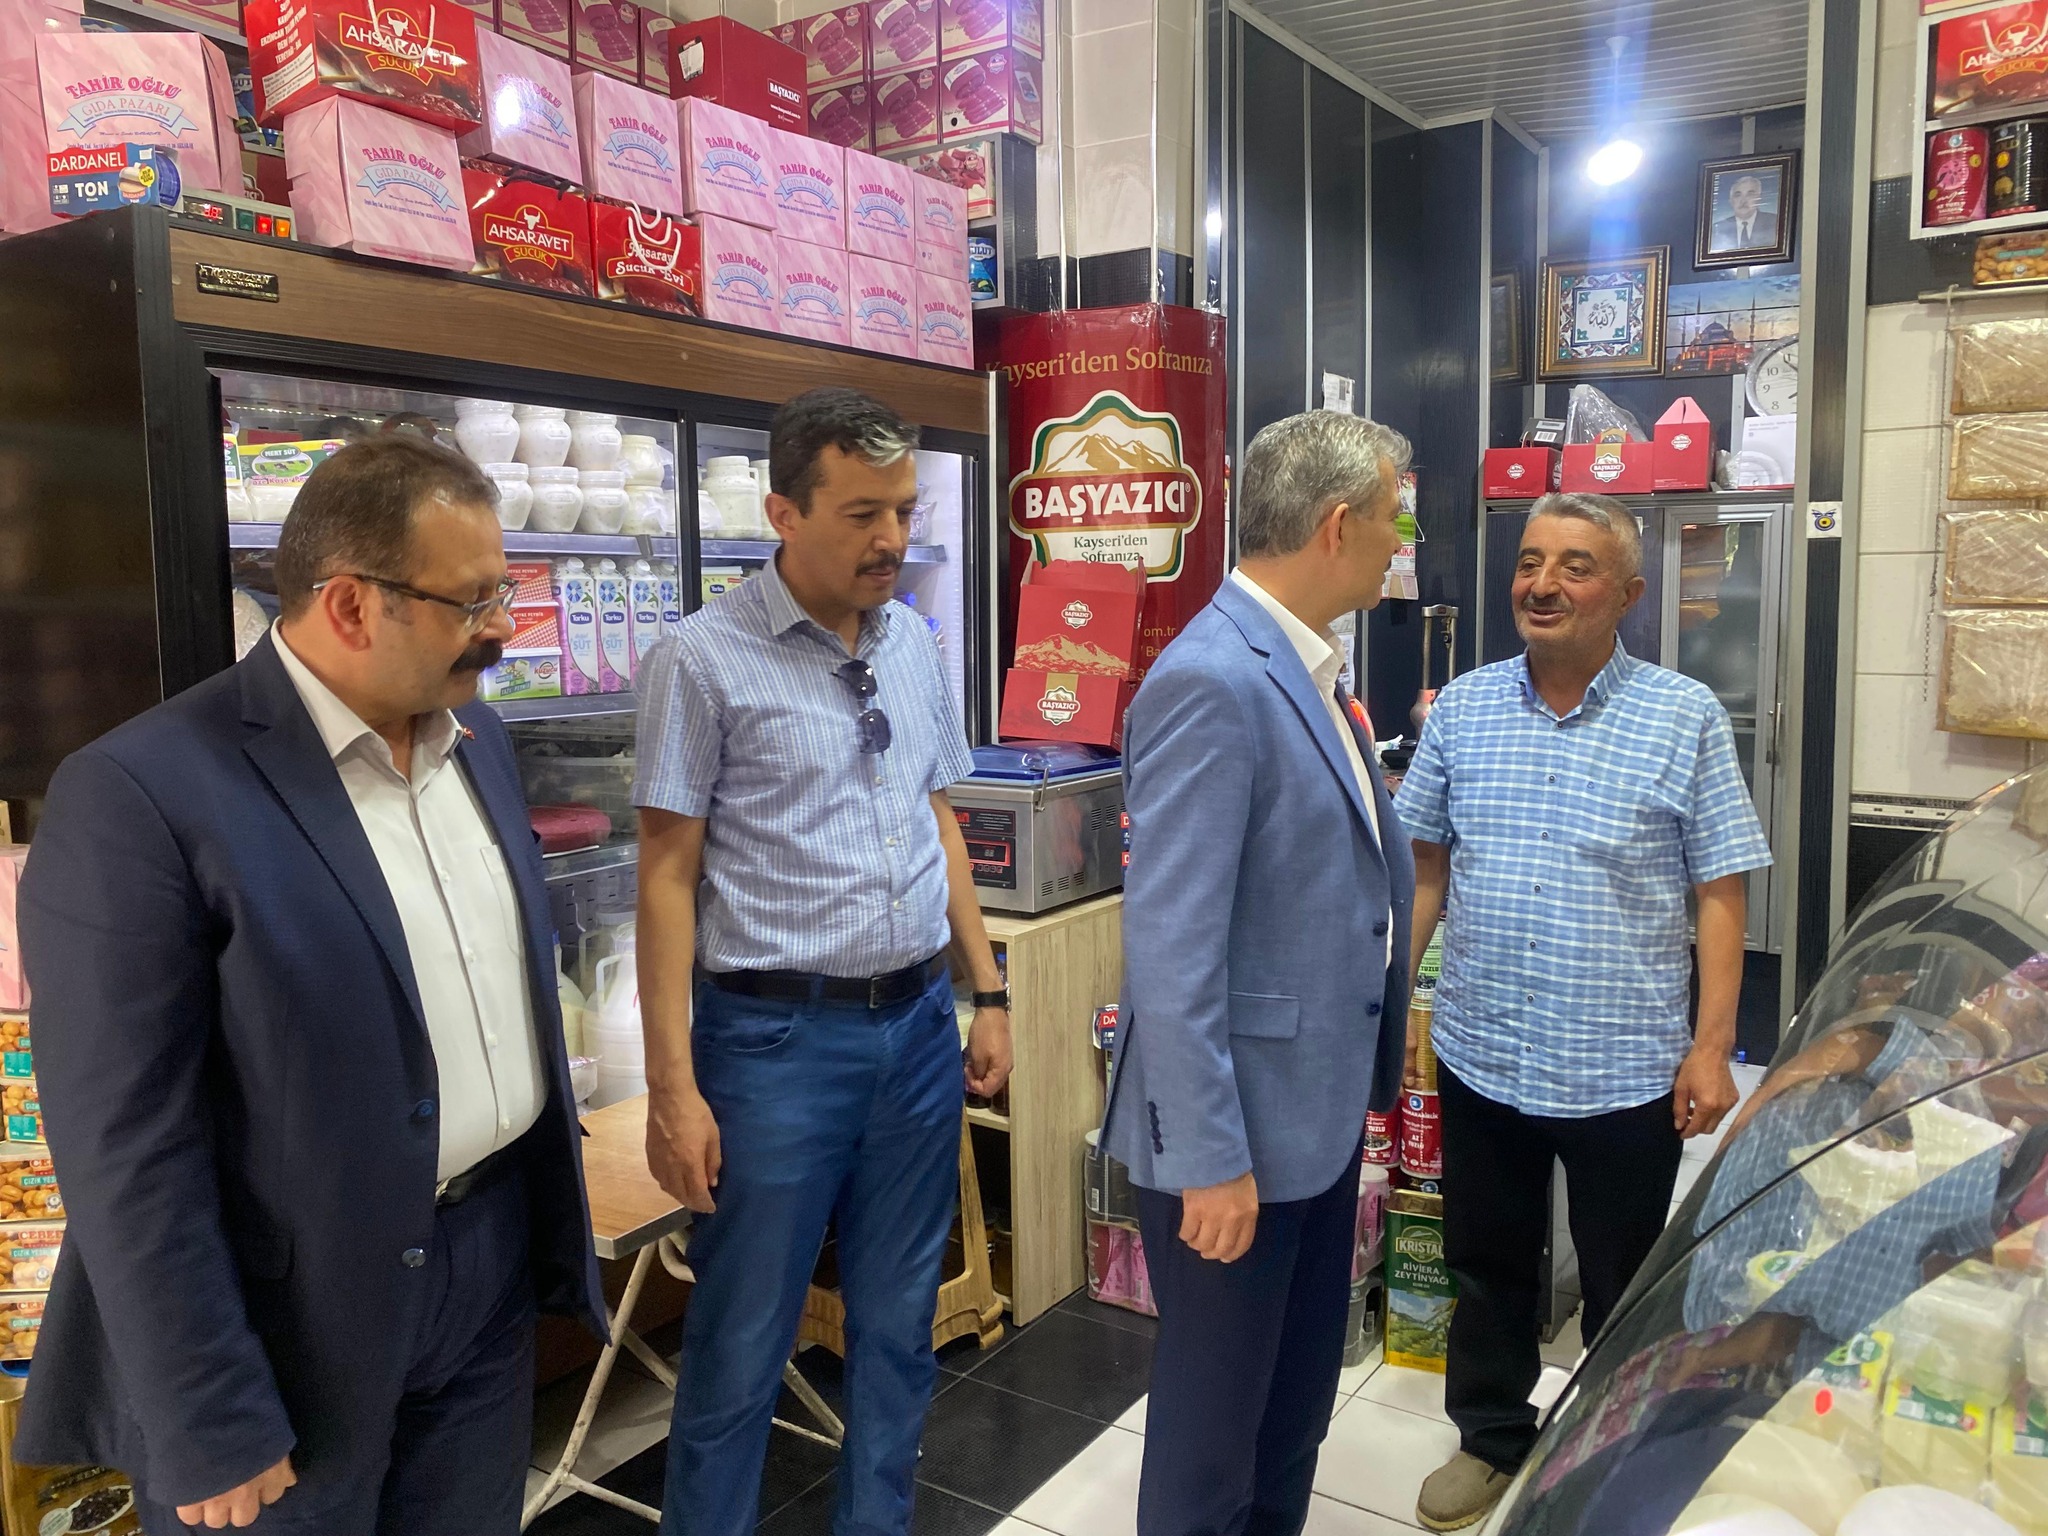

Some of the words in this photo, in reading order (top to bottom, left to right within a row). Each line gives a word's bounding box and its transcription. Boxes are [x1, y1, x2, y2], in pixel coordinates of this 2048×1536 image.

[65, 74, 125, 99] TAHİR
[128, 75, 182, 99] OĞLU
[81, 99, 116, 117] GIDA
[120, 97, 171, 117] PAZARI
[608, 115, 640, 131] TAHİR
[641, 121, 668, 145] OĞLU
[705, 136, 735, 149] TAHİR
[736, 140, 761, 162] OĞLU
[50, 151, 125, 173] DARDANEL
[362, 145, 407, 164] TAHİR
[408, 153, 447, 180] OĞLU
[375, 167, 401, 179] GIDA
[403, 168, 440, 194] PAZARI
[780, 162, 808, 175] TAHİR
[809, 167, 834, 187] OĞLU
[74, 180, 109, 199] TON
[858, 183, 884, 195] TAHİR
[488, 223, 570, 252] AHSARAYET
[513, 246, 547, 263] SUCUK
[717, 250, 745, 264] TAHİR
[745, 255, 769, 276] OĞLU
[786, 271, 815, 285] TAHİR
[815, 275, 840, 294] OĞLU
[861, 285, 886, 298] TAHİR
[924, 301, 946, 313] TAHİR
[1125, 345, 1213, 377] Sofranıza
[1767, 367, 1779, 377] 10
[1762, 384, 1771, 394] 9
[1771, 401, 1780, 410] 8
[1025, 481, 1186, 524] BAŞYAZICI
[1073, 534, 1148, 550] Kayseri'den
[1081, 551, 1141, 564] Sofranıza
[572, 614, 590, 622] Torku
[1394, 1270, 1450, 1286] ZEYTİNYAĞI
[1403, 1261, 1440, 1276] RİVİERA
